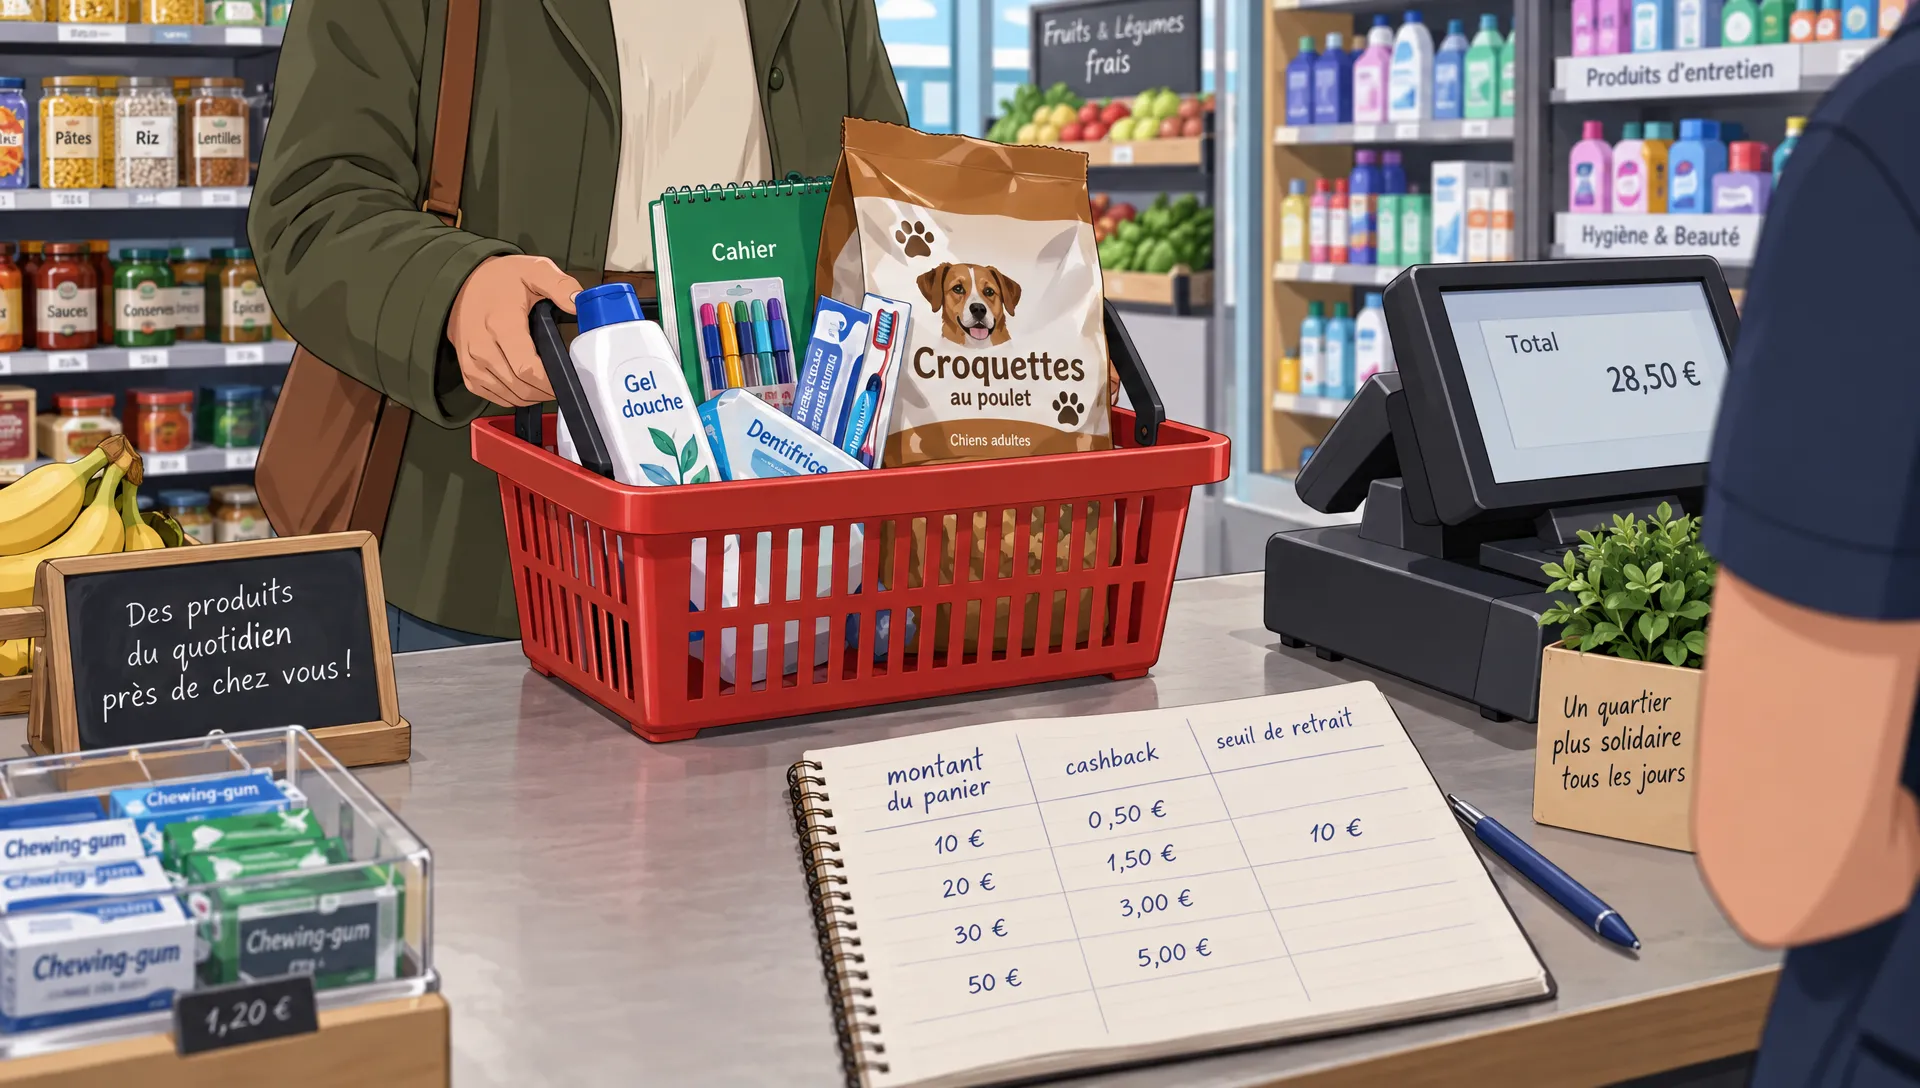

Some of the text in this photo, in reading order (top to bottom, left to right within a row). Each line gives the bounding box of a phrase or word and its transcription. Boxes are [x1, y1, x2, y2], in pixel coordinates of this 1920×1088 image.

[1044, 14, 1184, 47] Fruits & Légumes
[1085, 49, 1131, 83] frais
[1587, 59, 1774, 87] Produits d'entretien
[55, 131, 92, 145] Pâtes
[136, 131, 159, 145] Riz
[198, 132, 241, 145] Lentilles
[712, 240, 777, 262] Cahier
[1582, 225, 1740, 248] Hygiène & Beauté
[48, 305, 88, 318] Sauces
[1505, 332, 1559, 354] Total
[624, 370, 657, 393] Gel
[913, 346, 1085, 387] Croquettes
[1606, 360, 1701, 395] 28,50 €
[621, 394, 684, 419] douche
[950, 388, 1031, 410] au poulet
[746, 418, 828, 475] Dentifrice
[950, 434, 1031, 447] Chiens adultes
[126, 577, 293, 629] Des produits
[127, 623, 292, 671] du quotidien
[103, 681, 158, 722] près
[171, 675, 200, 701] de
[212, 666, 270, 695] chez
[1564, 689, 1672, 727] Un quartier
[1217, 707, 1353, 751] seuil de retrait
[1552, 724, 1682, 765] plus solidaire
[887, 747, 984, 787] montant
[1065, 742, 1160, 776] cashback
[1562, 763, 1686, 795] tous les jours
[147, 782, 260, 809] Chewing-gum
[887, 780, 991, 814] du panier
[1088, 799, 1168, 830] 0,50 €
[4, 829, 126, 860] Chewing-gum
[934, 829, 985, 855] 10 €
[1310, 818, 1363, 844] 10 €
[1106, 844, 1177, 874] 1,50 €
[943, 872, 996, 899] 20 €
[1120, 889, 1194, 920] 3,00 €
[246, 918, 370, 955] Chewing-gum
[954, 918, 1009, 946] 30 €
[33, 944, 180, 981] Chewing-gum
[1137, 938, 1212, 970] 5,00 €
[968, 968, 1023, 995] 50 €
[205, 996, 291, 1037] 1,20 €
